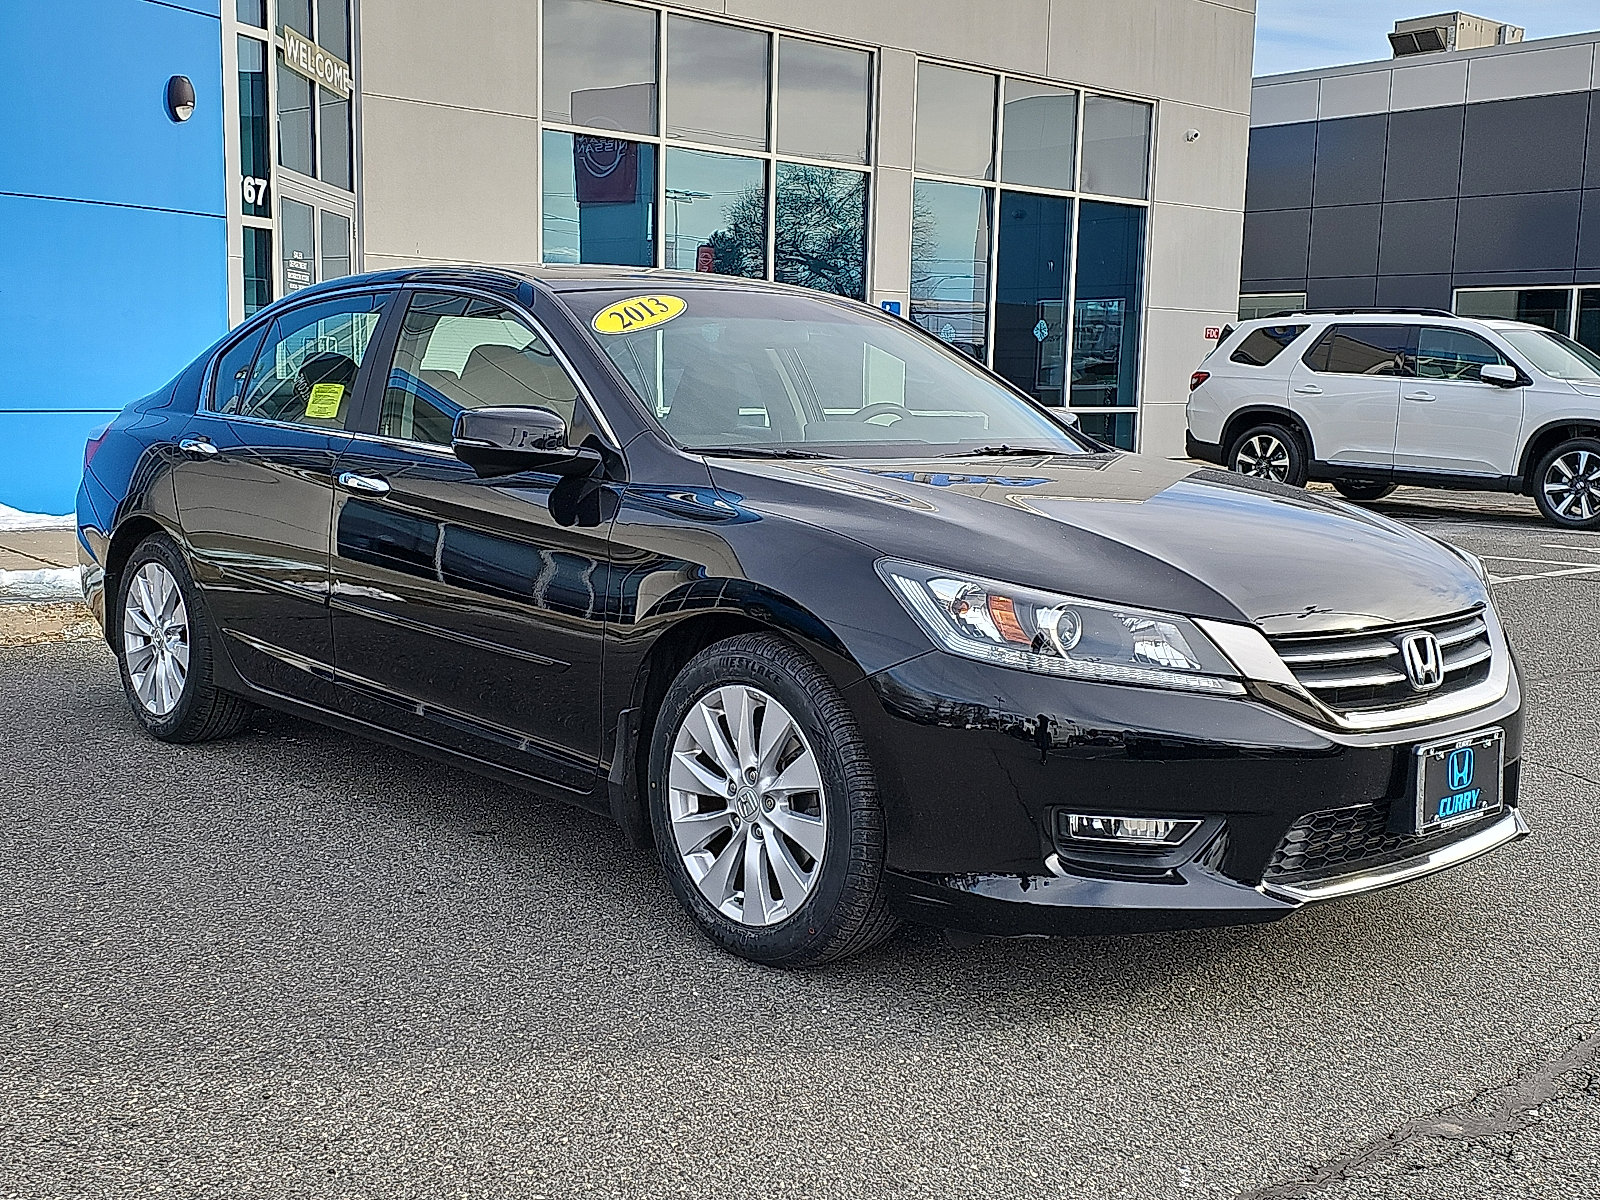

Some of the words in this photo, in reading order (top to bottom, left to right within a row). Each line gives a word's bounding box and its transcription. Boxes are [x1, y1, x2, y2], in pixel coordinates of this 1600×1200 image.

[284, 32, 349, 96] WELCOME
[240, 174, 267, 206] 67
[609, 298, 669, 329] 2013
[1206, 328, 1219, 338] FDC
[1439, 788, 1481, 817] CURRY
